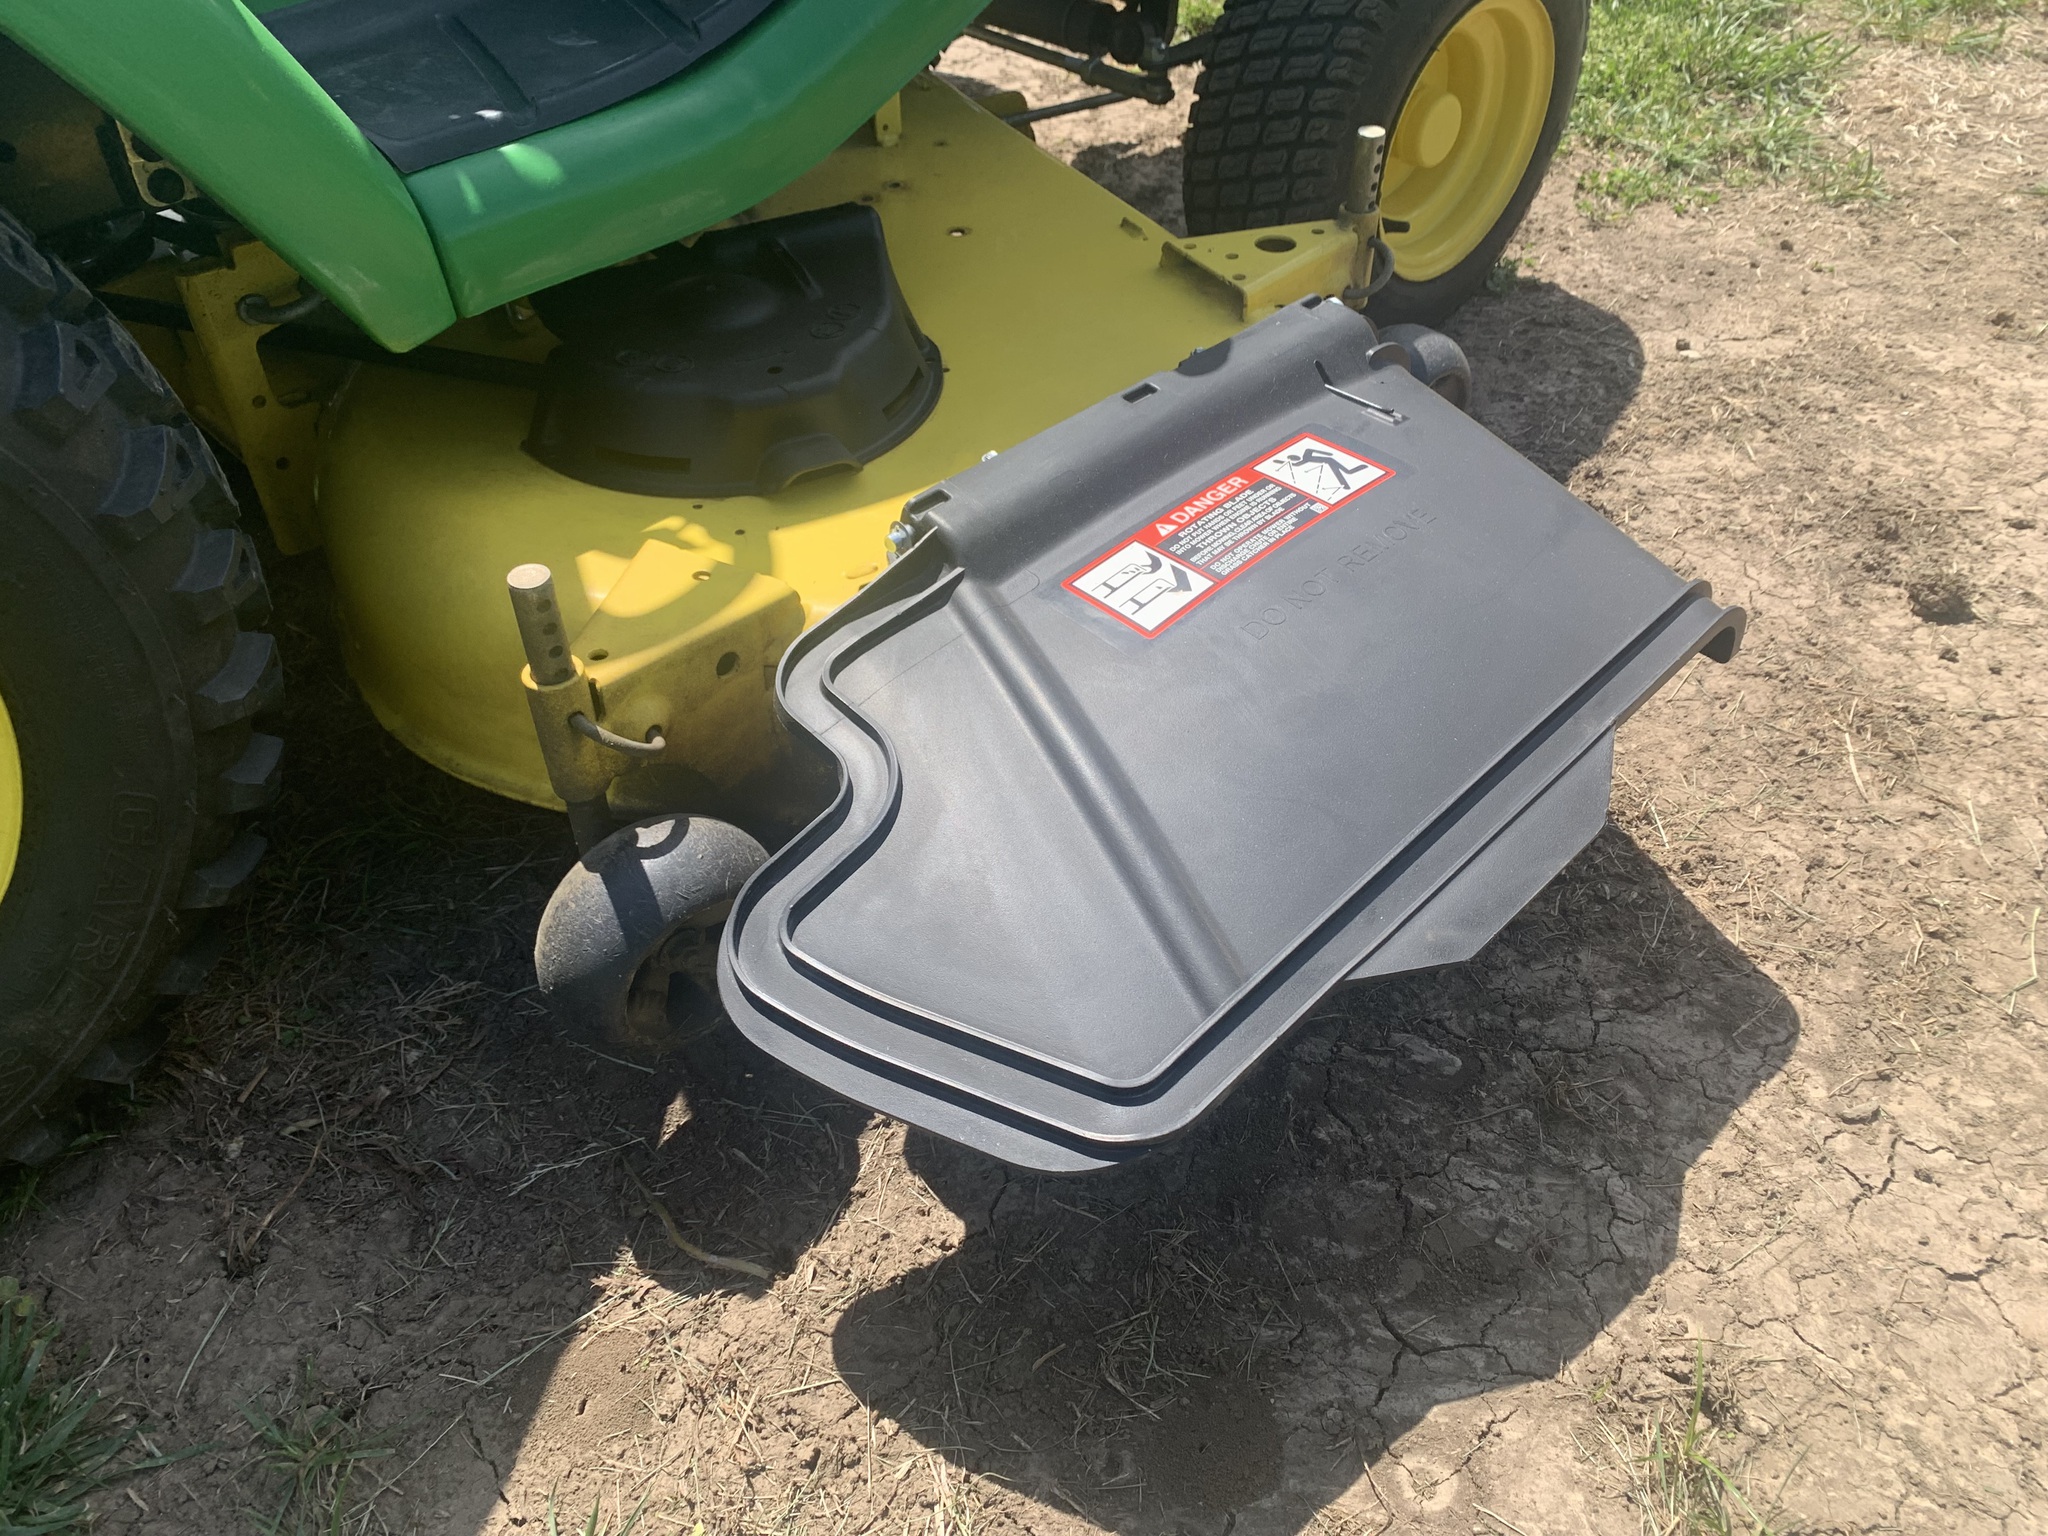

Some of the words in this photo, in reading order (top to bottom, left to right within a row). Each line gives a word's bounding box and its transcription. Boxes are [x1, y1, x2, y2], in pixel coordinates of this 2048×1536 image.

[1167, 543, 1182, 551] DO
[1177, 535, 1194, 545] NOT
[1189, 527, 1206, 537] PUT
[1201, 514, 1226, 529] HANDS
[1230, 500, 1248, 511] FEET
[1244, 488, 1267, 502] UNDER
[1170, 476, 1249, 523] DANGER
[1174, 543, 1193, 555] INTO
[1188, 528, 1215, 545] MOWER
[1210, 517, 1232, 530] WHEN
[1227, 504, 1252, 519] ENGINE
[1254, 485, 1283, 503] RUNNING
[1176, 507, 1225, 537] ROTATING
[1221, 488, 1255, 508] BLADE
[1188, 546, 1215, 562] BEFORE
[1232, 519, 1254, 533] CLEAR
[1249, 510, 1268, 521] AREA
[1270, 492, 1298, 508] OBJECTS
[1194, 521, 1239, 549] THROWN
[1234, 496, 1278, 523] OBJECTS
[1194, 553, 1215, 566] THAT
[1210, 544, 1227, 555] MAY
[1231, 523, 1259, 541] THROWN
[1263, 506, 1286, 520] BLADE
[1208, 561, 1222, 569] DO
[1218, 552, 1235, 562] NOT
[1232, 533, 1264, 553] OPERATE
[1260, 518, 1287, 535] MOWER
[1283, 502, 1312, 520] WITHOUT
[1213, 548, 1252, 572] DISCHARGE
[1247, 535, 1270, 549] CHUTE
[1275, 516, 1299, 531] ENTIRE
[1219, 559, 1244, 575] GRASS
[1239, 541, 1270, 561] CATCHER
[1273, 524, 1296, 538] PLACE
[1240, 608, 1287, 640] DO
[1284, 567, 1340, 609] NOT
[1337, 508, 1437, 572] REMOVE
